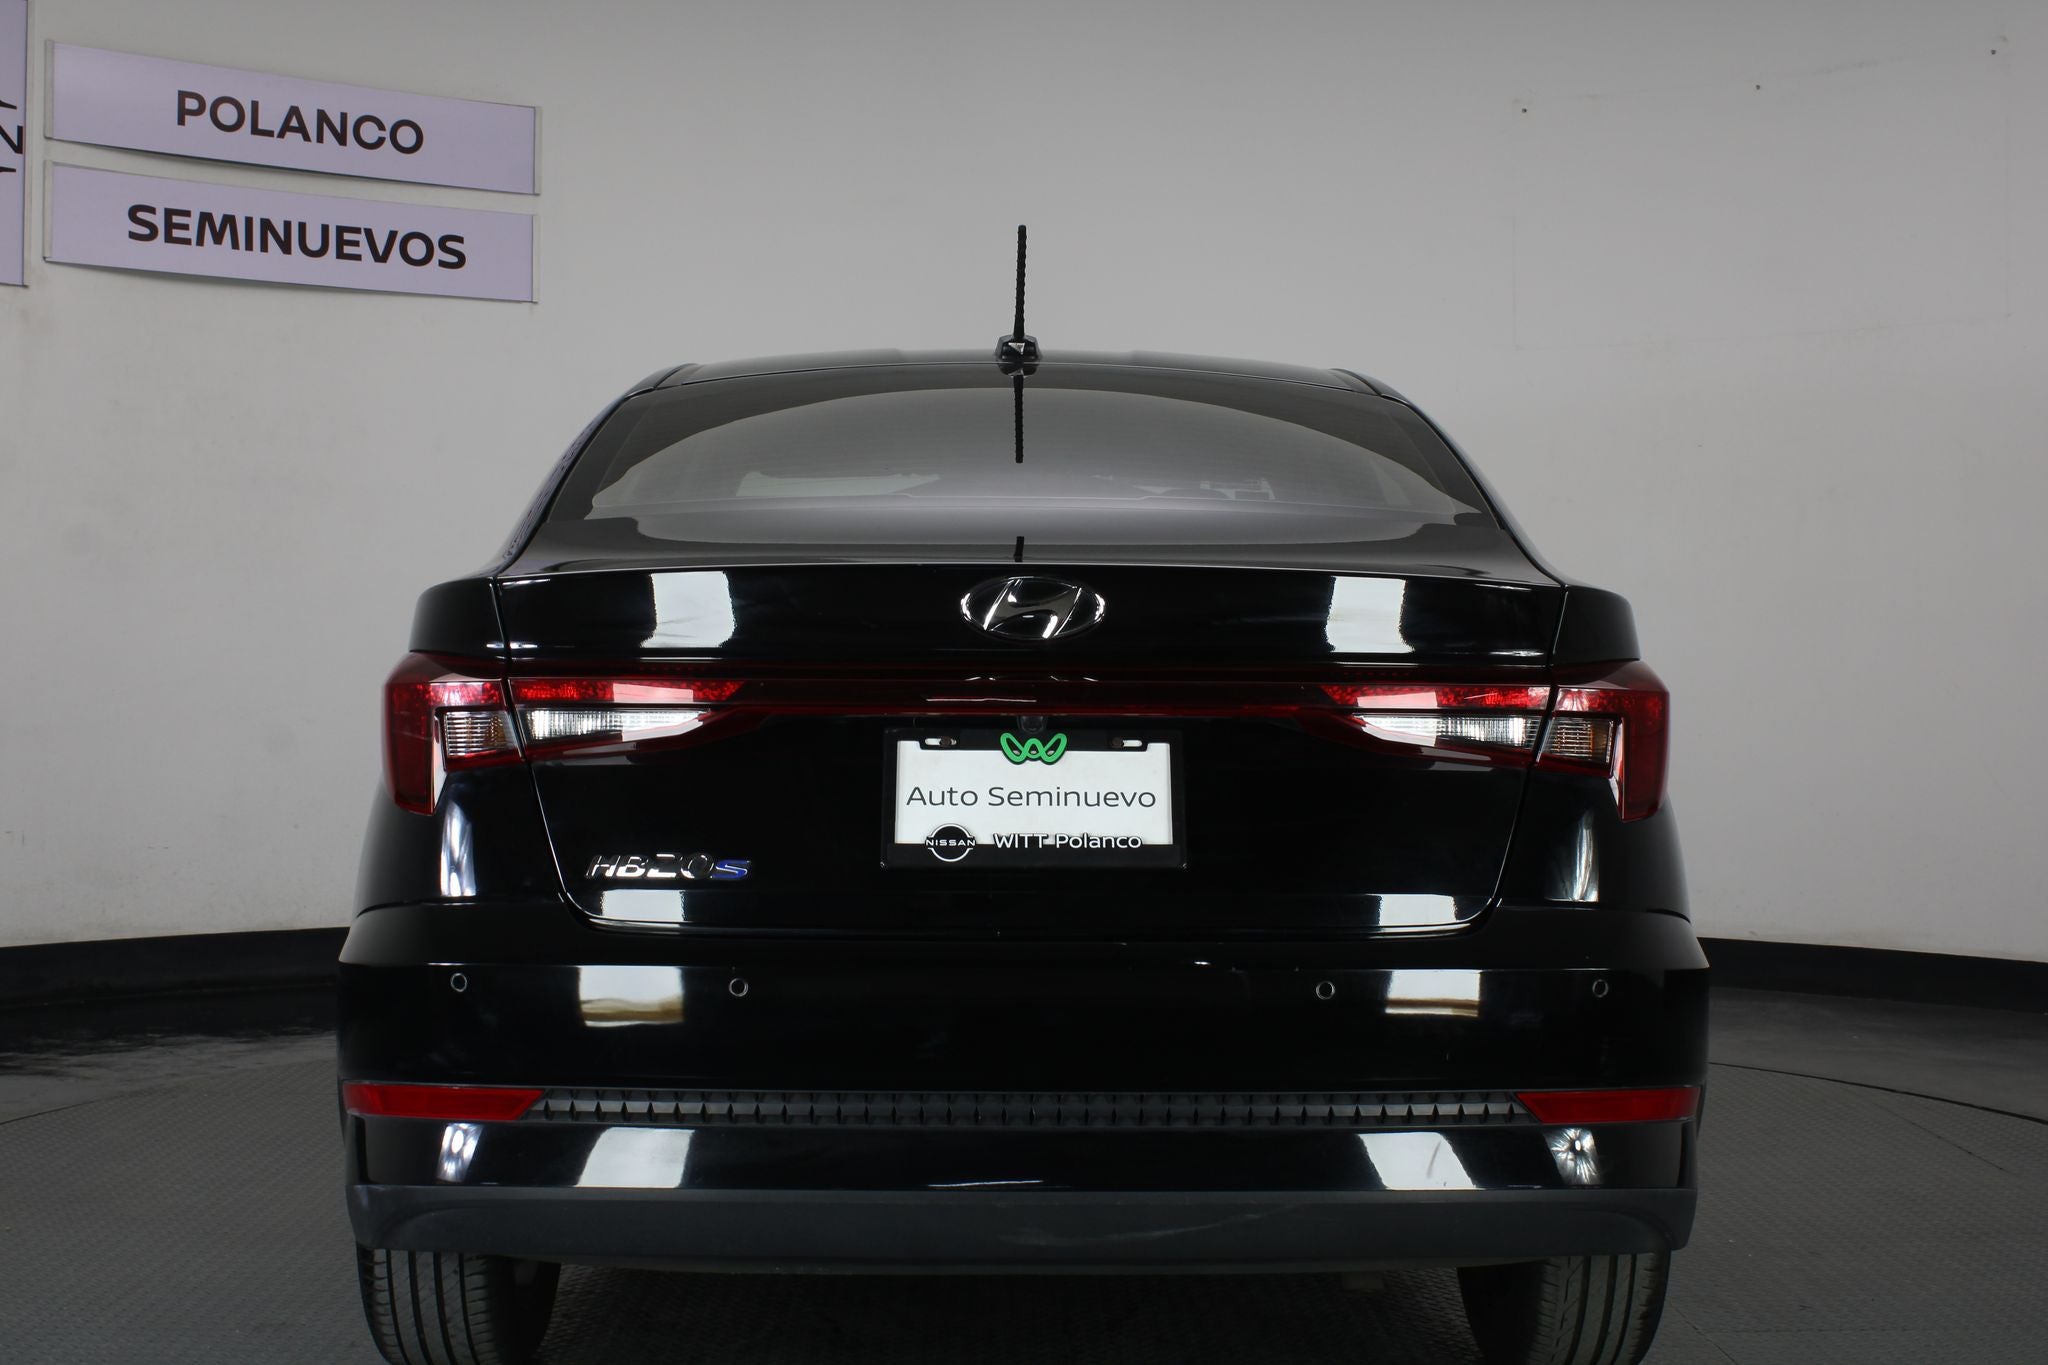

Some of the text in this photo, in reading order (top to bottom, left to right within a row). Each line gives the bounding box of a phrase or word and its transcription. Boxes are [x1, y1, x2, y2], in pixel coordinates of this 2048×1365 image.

[176, 89, 424, 155] POLANCO
[127, 204, 467, 270] SEMINUEVOS
[906, 786, 1156, 808] Auto Seminuevo
[925, 838, 976, 847] NISSAN
[992, 832, 1142, 849] WITT Polanco
[586, 853, 751, 880] HB20S
